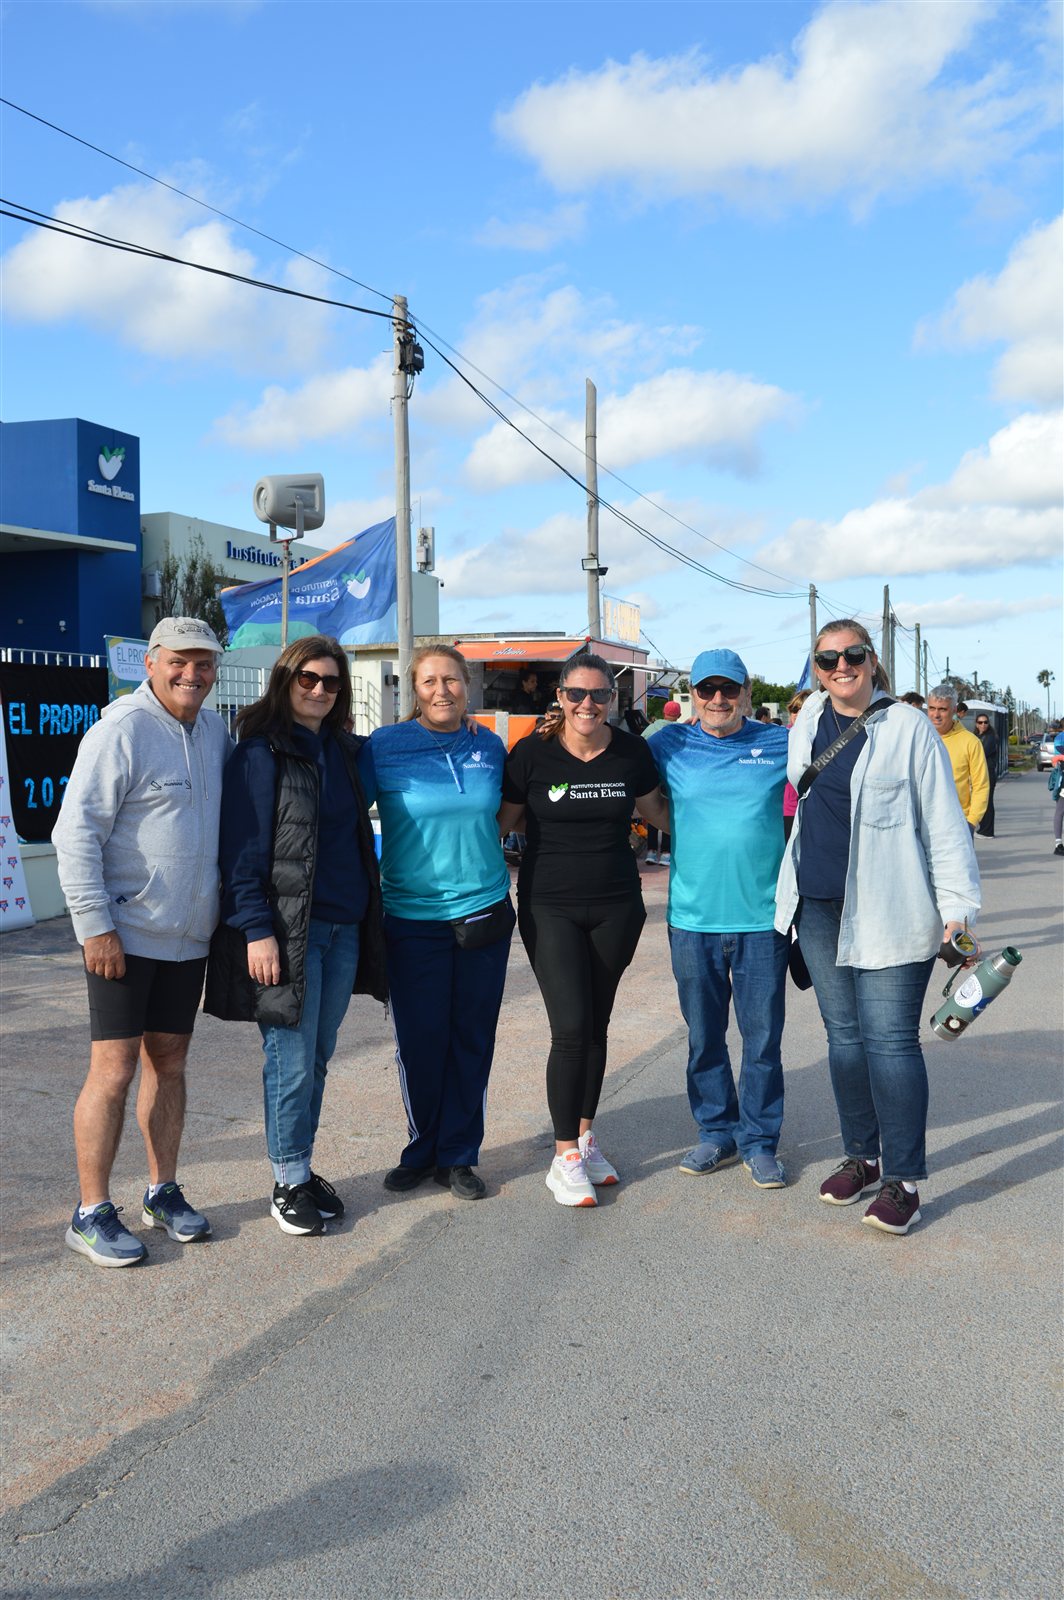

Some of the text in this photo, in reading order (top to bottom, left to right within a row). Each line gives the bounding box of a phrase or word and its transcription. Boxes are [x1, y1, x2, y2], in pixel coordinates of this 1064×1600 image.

[88, 480, 135, 501] Santa Elena
[226, 541, 282, 567] Instituto
[117, 646, 127, 662] EL
[9, 702, 99, 735] EL PROPIO
[812, 737, 849, 772] PRUNE
[570, 788, 626, 799] Santa Elena
